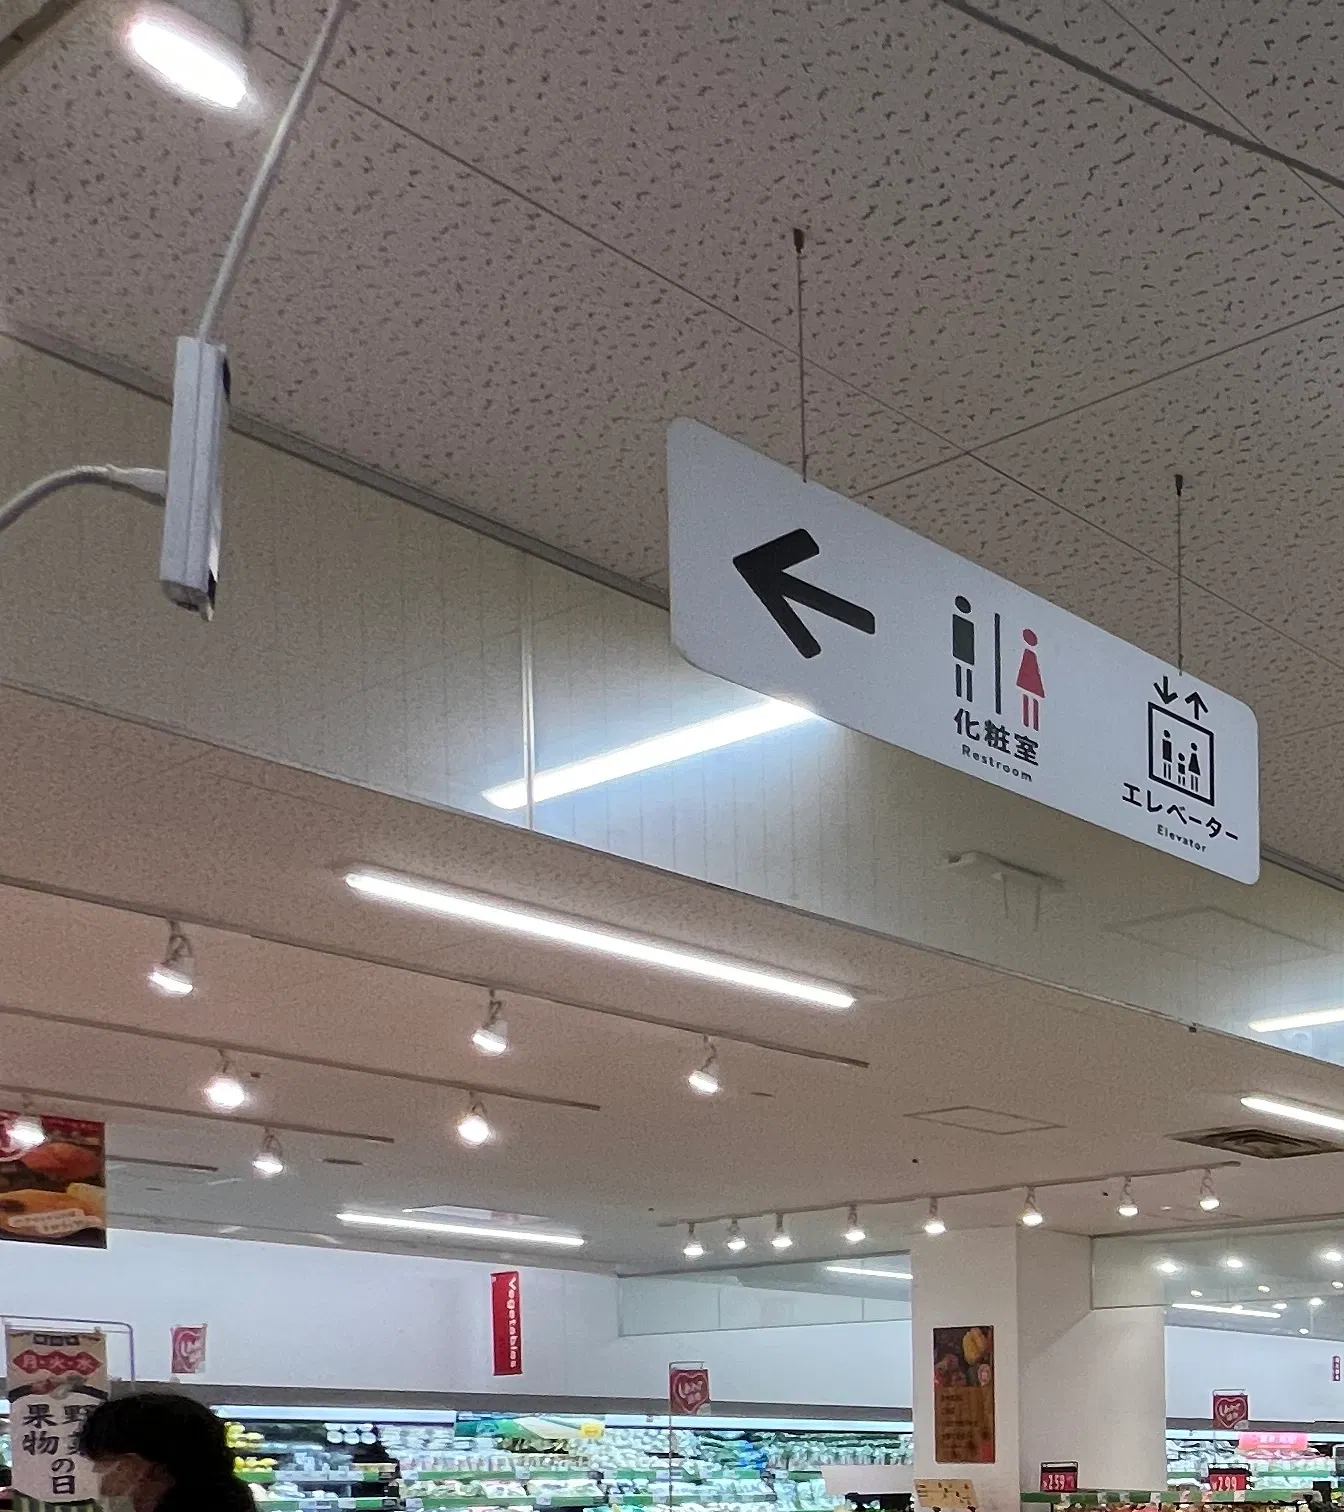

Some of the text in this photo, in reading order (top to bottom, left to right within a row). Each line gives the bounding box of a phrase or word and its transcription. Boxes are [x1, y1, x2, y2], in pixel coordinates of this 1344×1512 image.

[953, 708, 1039, 767] 化粧室
[961, 744, 1033, 782] Restroom
[1121, 781, 1239, 842] エレベーター
[1157, 824, 1207, 853] Elevator
[23, 1404, 58, 1456] 果物
[51, 1458, 76, 1494] の日
